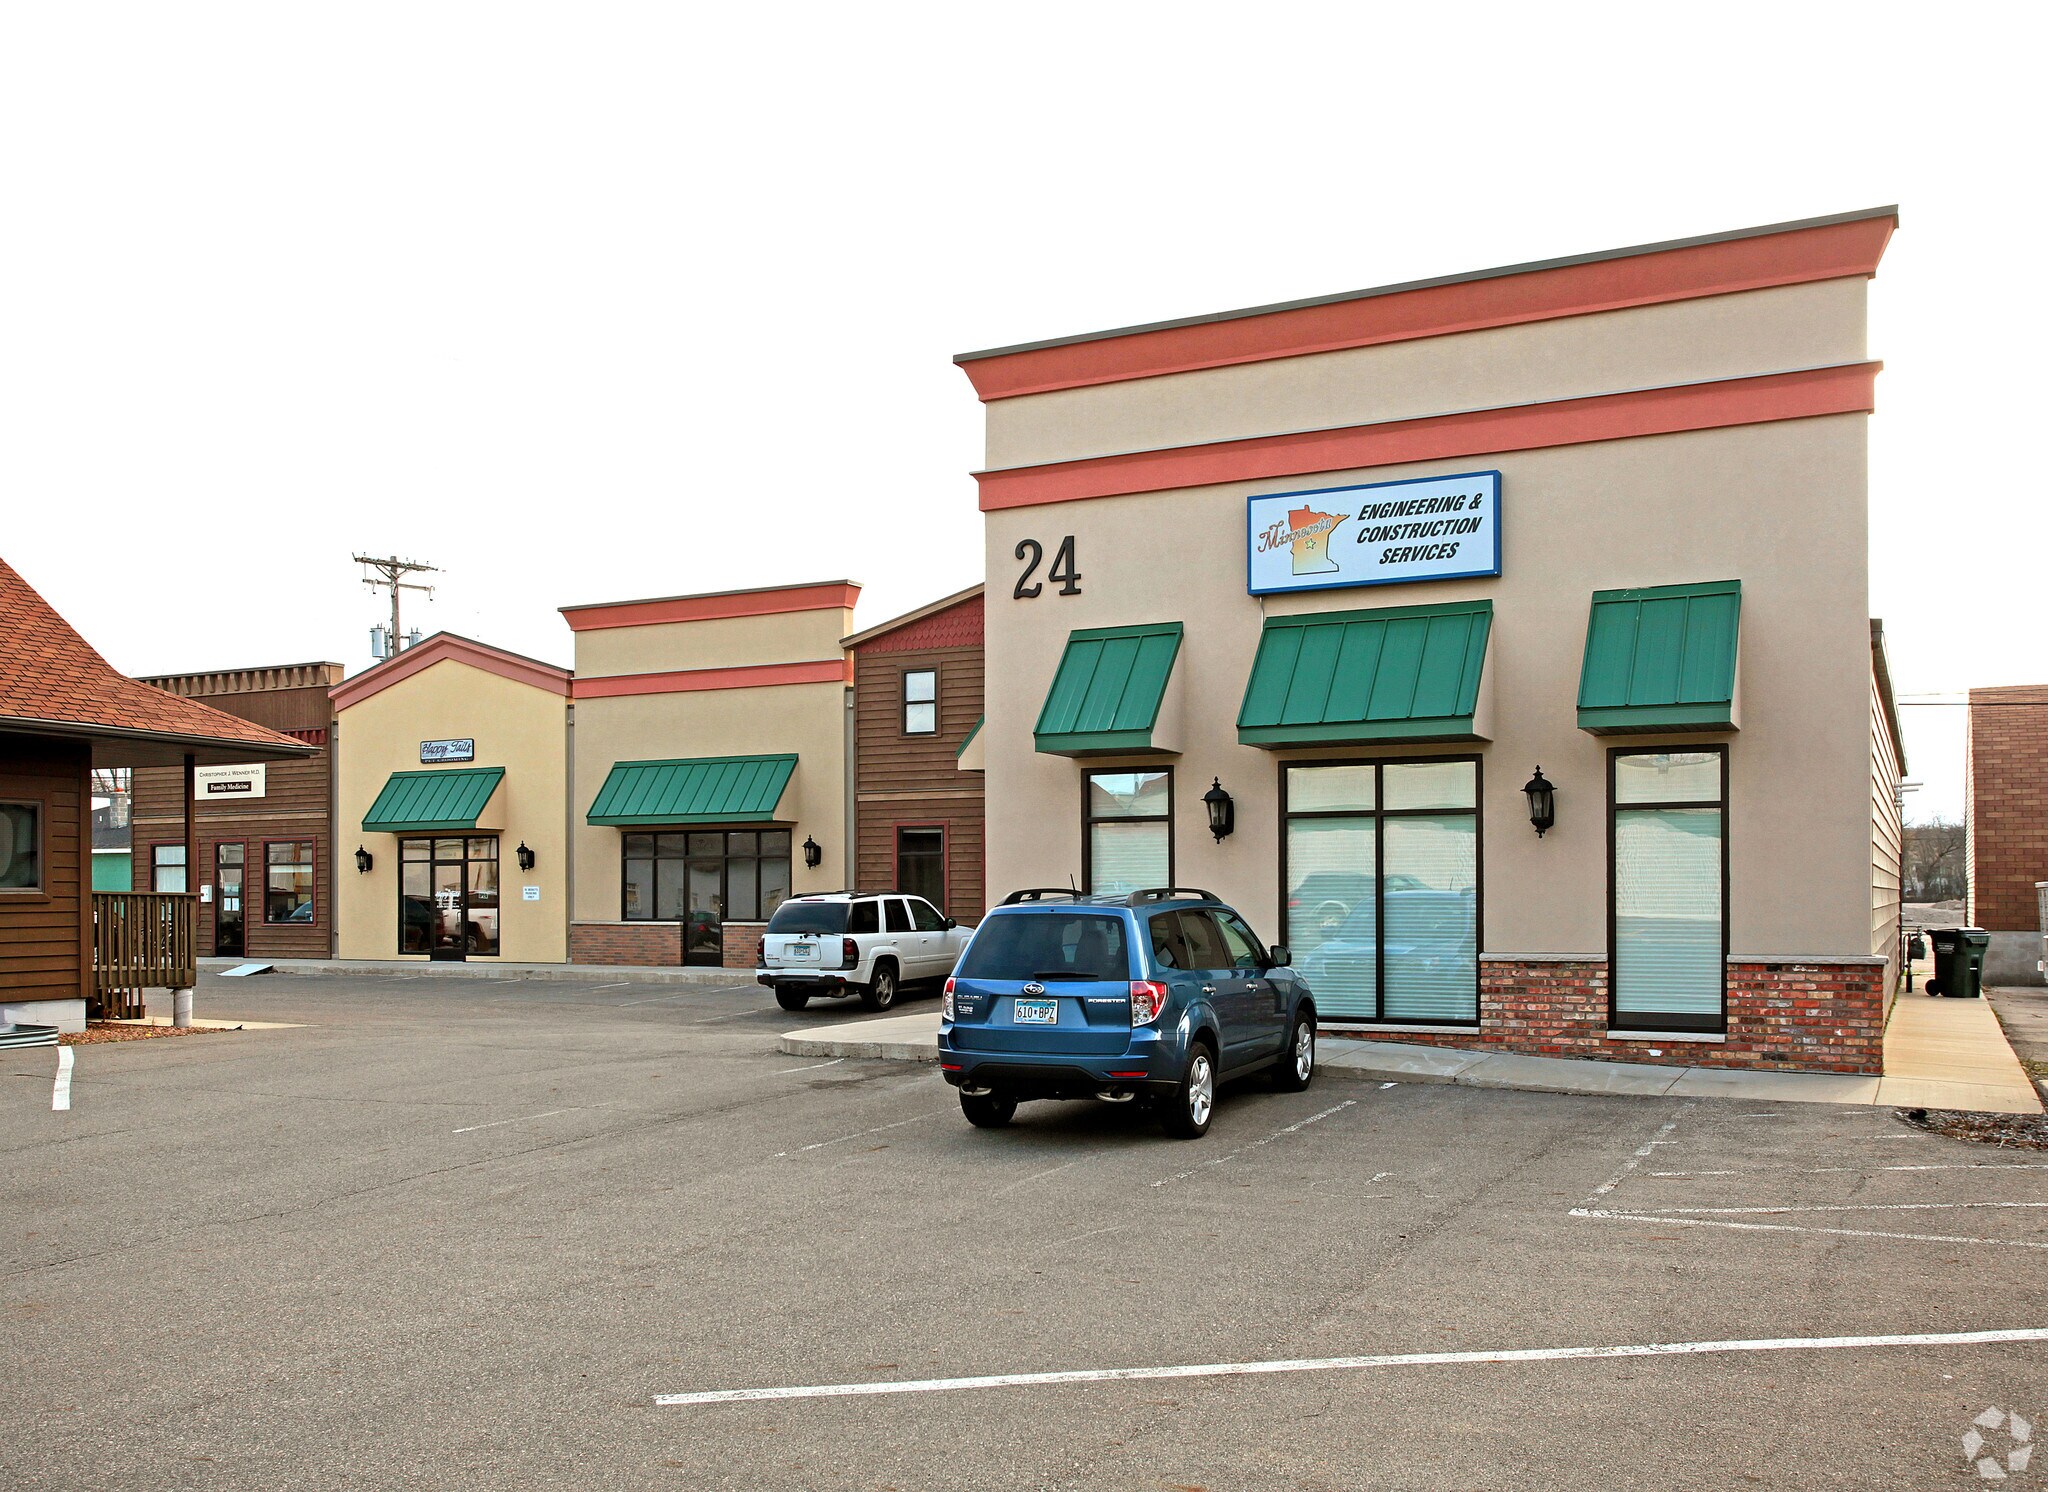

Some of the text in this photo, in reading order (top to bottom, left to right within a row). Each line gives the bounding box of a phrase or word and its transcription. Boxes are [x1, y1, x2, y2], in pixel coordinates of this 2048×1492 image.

[1357, 492, 1483, 521] ENGINEERING &
[1257, 519, 1332, 553] Minnesota
[1356, 516, 1483, 544] CONSTRUCTION
[1013, 535, 1082, 600] 24
[1379, 542, 1460, 565] SERVICES
[422, 741, 471, 757] Happy Tails
[210, 783, 227, 791] Family
